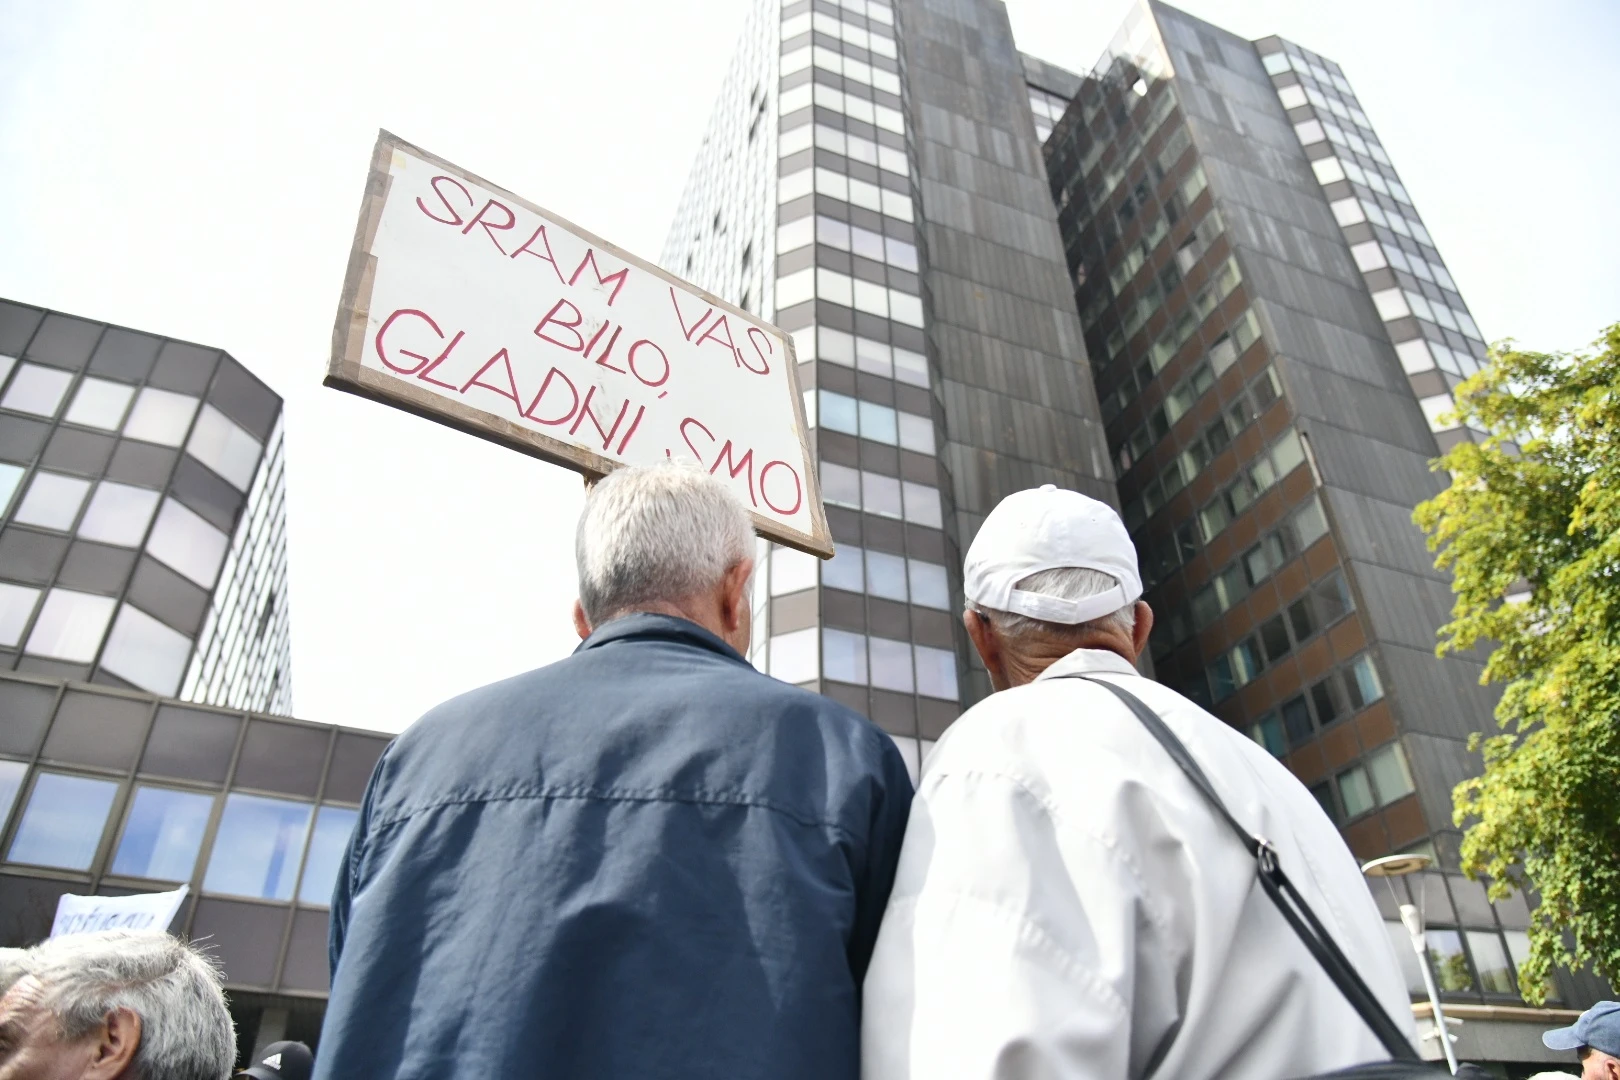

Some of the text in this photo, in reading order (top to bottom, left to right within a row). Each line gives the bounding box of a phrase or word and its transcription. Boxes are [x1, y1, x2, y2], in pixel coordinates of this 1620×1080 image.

[416, 175, 773, 375] SRAM VAS
[533, 298, 669, 399] BILO,
[375, 308, 646, 455] GLADNI
